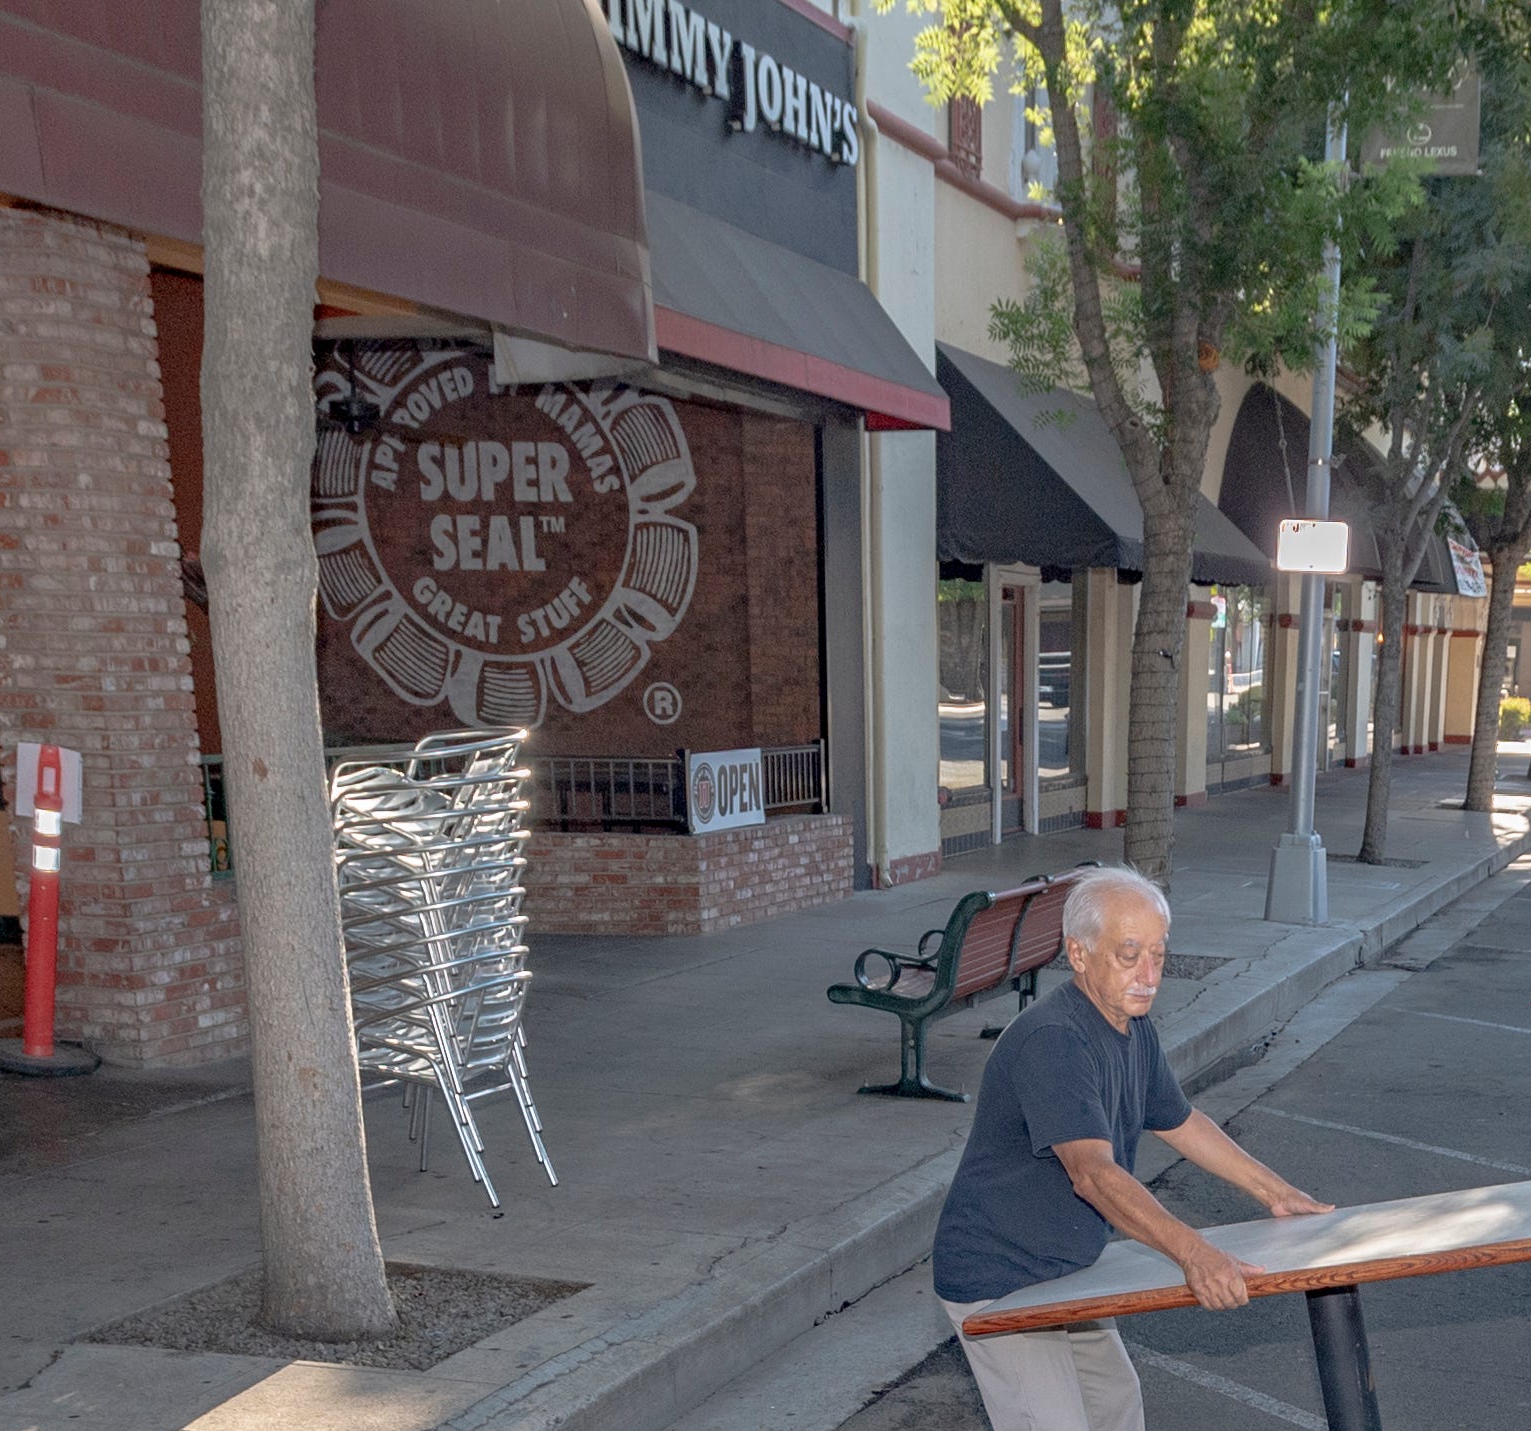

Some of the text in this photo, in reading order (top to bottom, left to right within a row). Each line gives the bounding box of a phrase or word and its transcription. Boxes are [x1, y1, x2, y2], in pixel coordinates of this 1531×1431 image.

[599, 0, 859, 167] IMMY JOHN'S
[1424, 145, 1458, 158] LEXUS
[418, 440, 574, 502] SUPER
[535, 387, 619, 495] MAMAS
[412, 574, 593, 645] GREAT STUFF
[717, 762, 761, 817] OPEN
